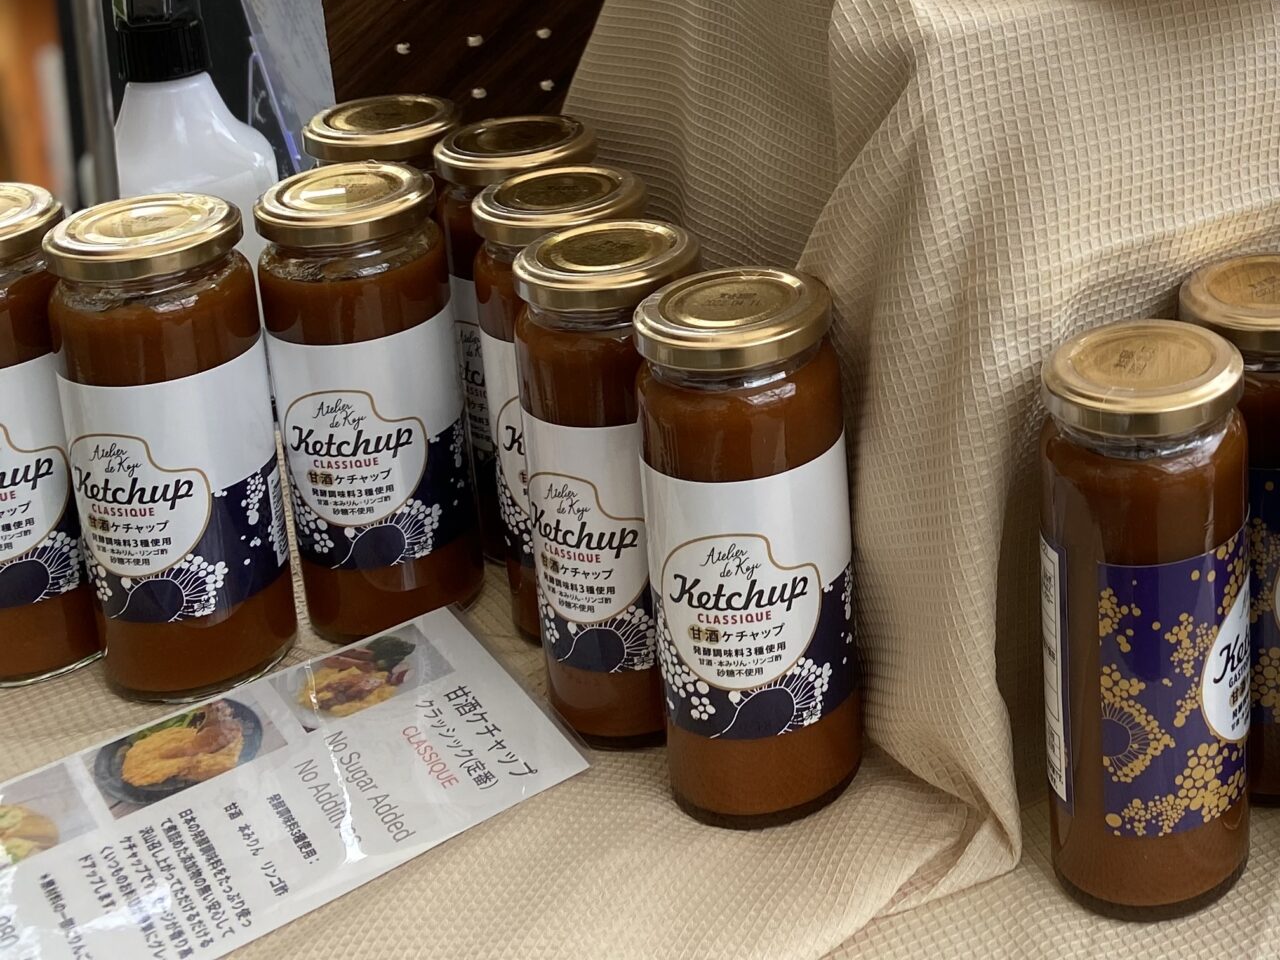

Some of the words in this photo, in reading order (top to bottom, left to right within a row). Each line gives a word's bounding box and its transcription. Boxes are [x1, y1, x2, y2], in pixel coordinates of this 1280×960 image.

[312, 398, 353, 419] Atelier
[329, 414, 340, 428] de
[290, 425, 413, 459] Ketchup
[90, 443, 127, 461] Atelier
[105, 459, 115, 473] de
[313, 457, 379, 470] CLASSIQUE
[308, 467, 392, 485] 甘酒ケチャップ
[74, 465, 194, 510] Ketchup
[312, 484, 394, 498] 発酵調味料3種使用
[544, 484, 578, 502] Atelier
[91, 503, 155, 518] CLASSIQUE
[333, 507, 374, 515] 砂糖不使用
[556, 500, 566, 515] de
[88, 514, 169, 534] 甘酒ケチャップ
[531, 501, 638, 559] Ketchup
[110, 556, 151, 566] 砂糖不使用
[544, 542, 601, 564] CLASSIQUE
[700, 543, 748, 567] Atelier
[541, 556, 614, 580] 甘酒ケチャップ
[719, 561, 733, 578] de
[669, 573, 808, 612] Ketchup
[558, 598, 595, 614] 砂糖不使用
[697, 610, 772, 625] CLASSIQUE
[690, 622, 785, 642] 甘酒ケチャップ
[693, 642, 786, 658] 発酵調味料3種使用
[716, 667, 764, 677] 砂糖不使用
[444, 685, 538, 776] 甘酒ケチャップ
[402, 725, 460, 789] CLASSIQUE
[294, 759, 319, 783] No
[324, 730, 348, 753] No
[340, 751, 378, 793] Sugar
[367, 793, 417, 844] Added
[223, 802, 244, 821] 甘酒
[238, 823, 265, 856] 本みりん
[261, 861, 289, 897] リンゴ酢
